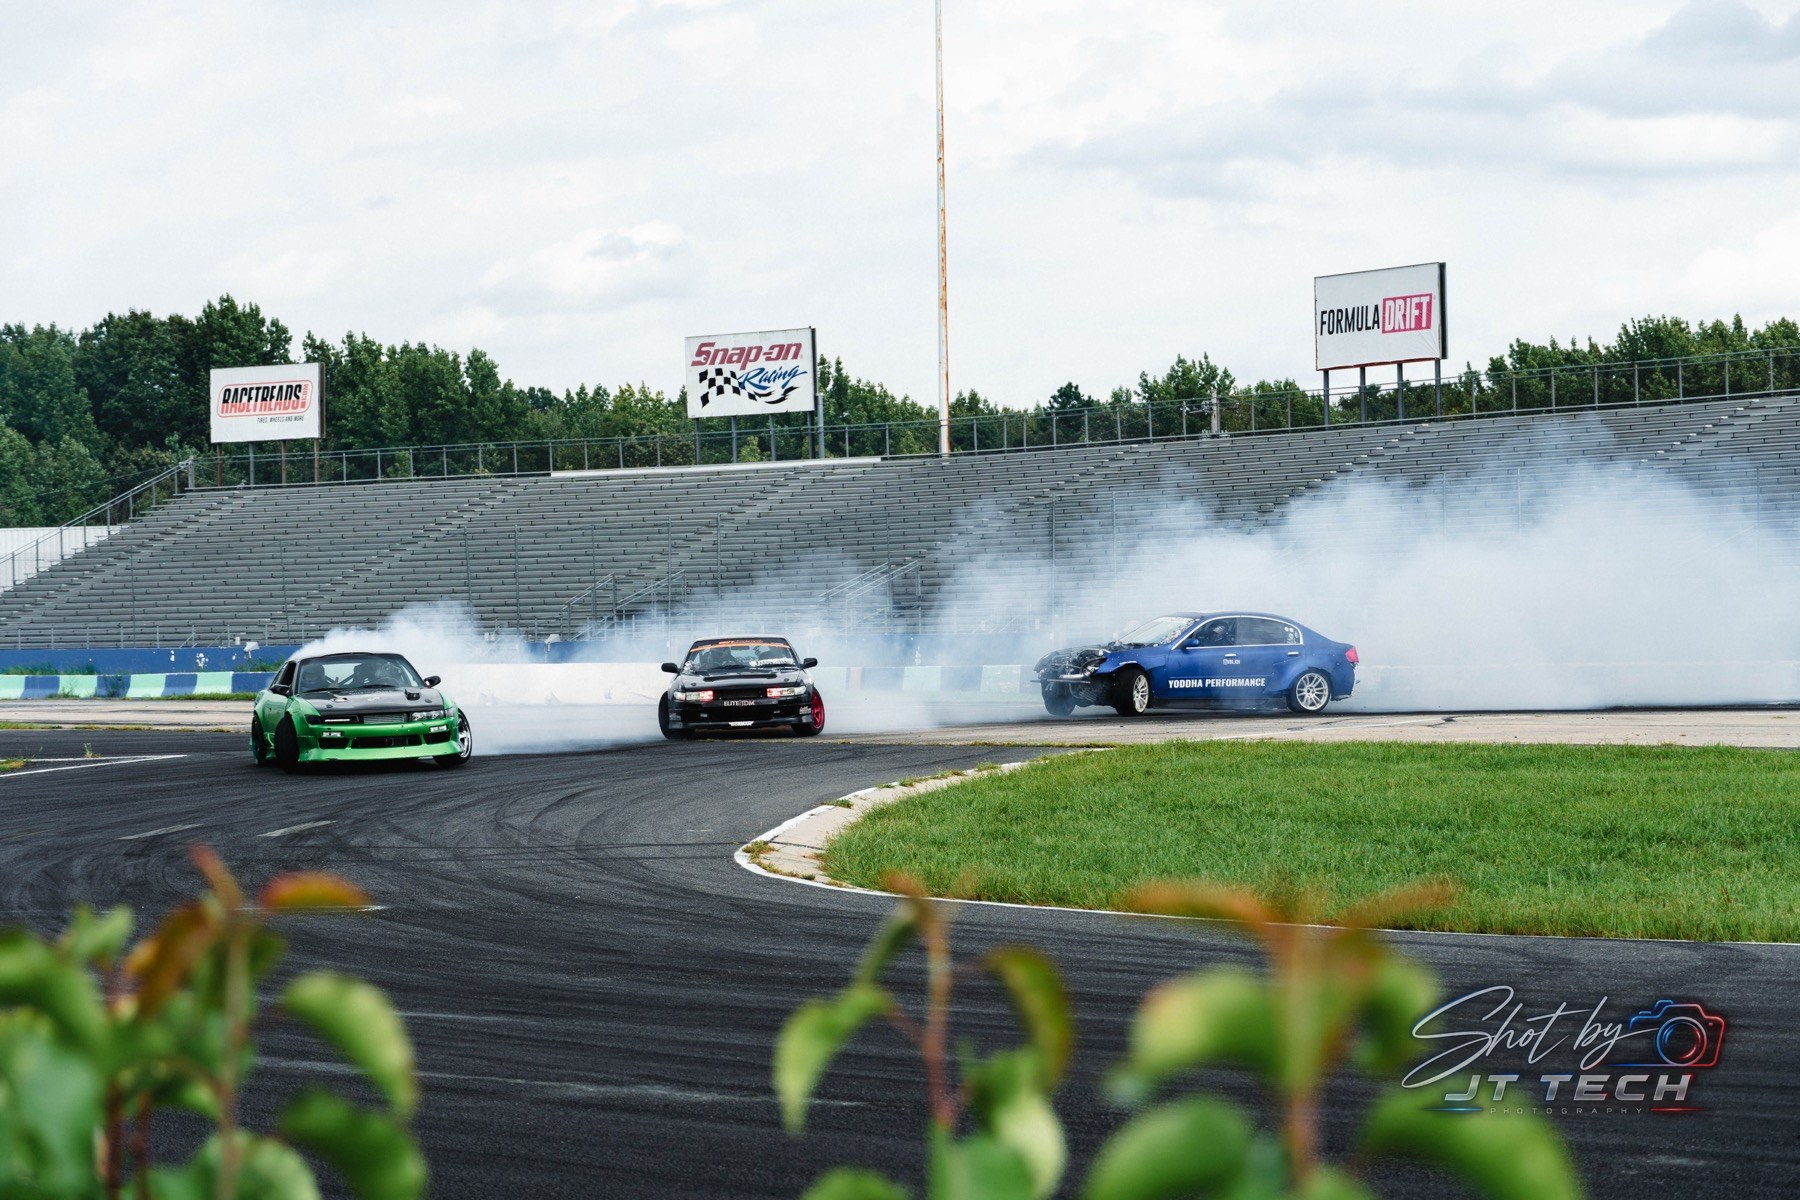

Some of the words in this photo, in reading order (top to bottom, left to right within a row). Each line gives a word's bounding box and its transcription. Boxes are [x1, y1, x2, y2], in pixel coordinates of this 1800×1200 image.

[1320, 304, 1380, 336] FORMULA
[1384, 295, 1430, 331] DRIFT
[691, 341, 802, 370] Snap-on
[737, 365, 807, 390] Racing
[221, 383, 302, 414] RACETREADS
[1168, 679, 1203, 688] YODDHA
[1205, 678, 1266, 687] PERFORMANCE
